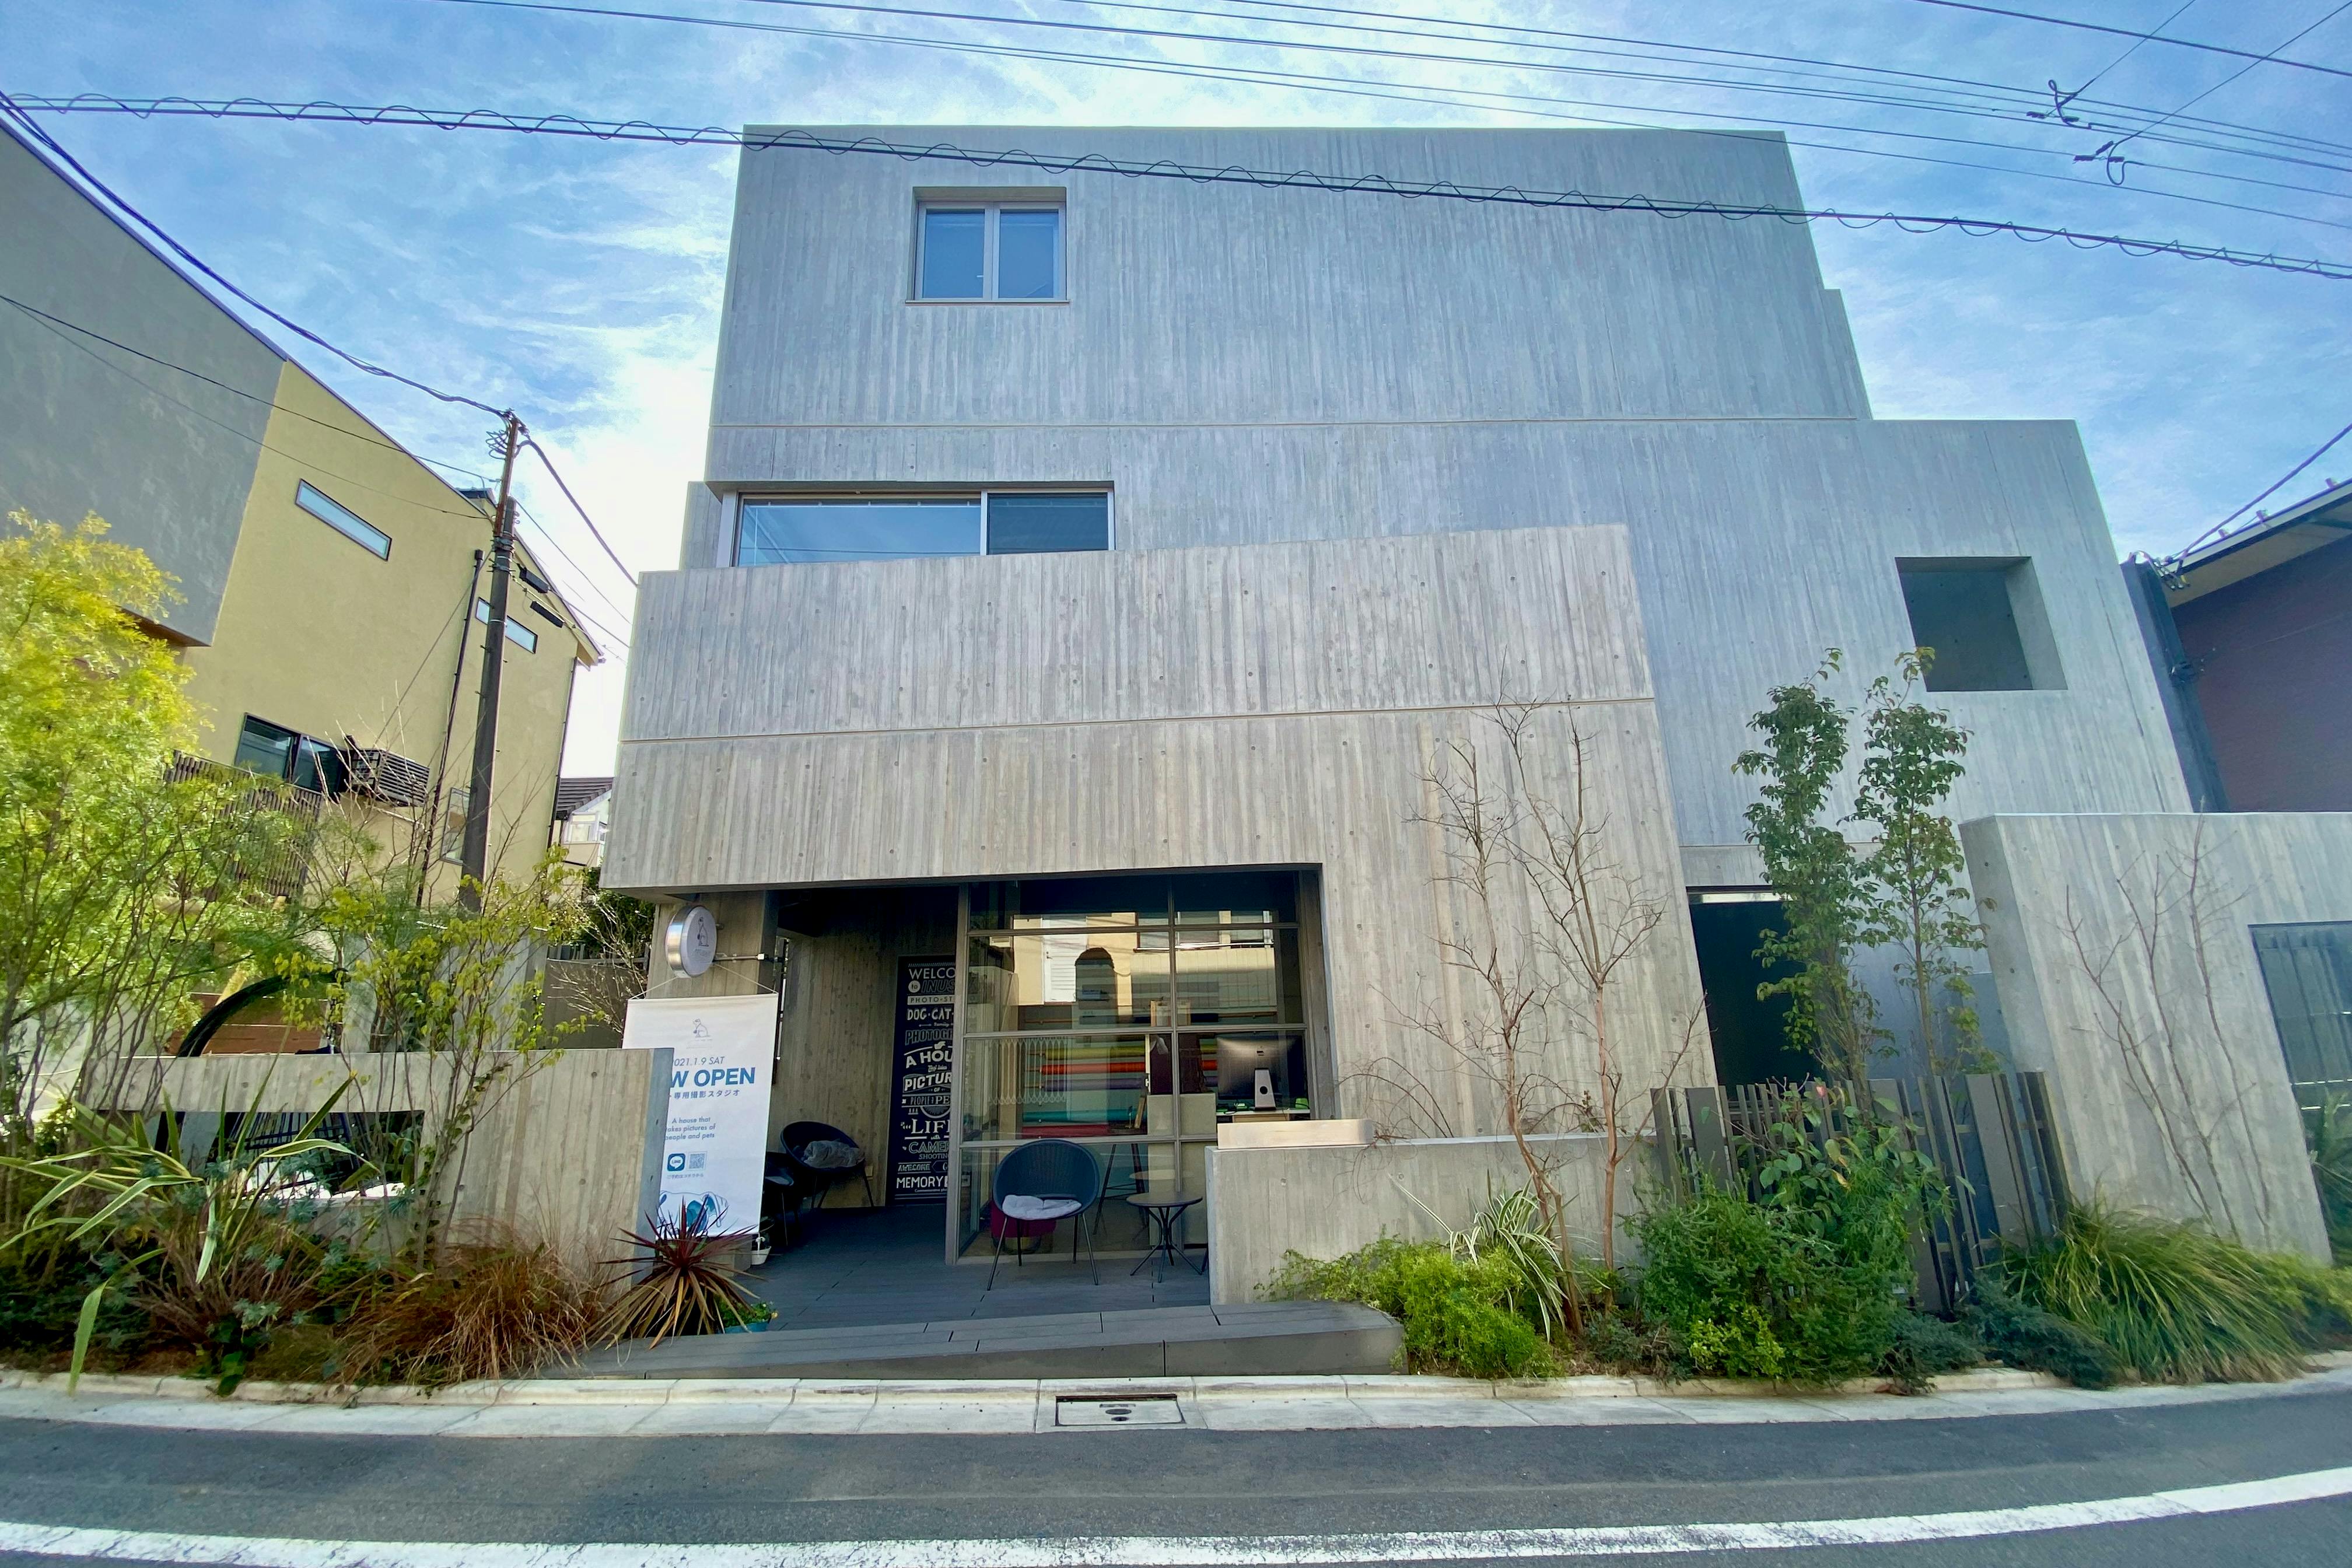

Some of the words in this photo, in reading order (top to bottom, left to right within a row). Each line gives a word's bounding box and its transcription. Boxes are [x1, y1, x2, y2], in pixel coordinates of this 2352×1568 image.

[909, 967, 956, 979] WELCO
[673, 1057, 706, 1066] 021.1.9
[709, 1056, 725, 1065] SAT
[906, 1055, 917, 1069] A
[920, 1050, 952, 1063] HOU
[694, 1067, 755, 1087] OPEN
[904, 1072, 951, 1091] PICTUR
